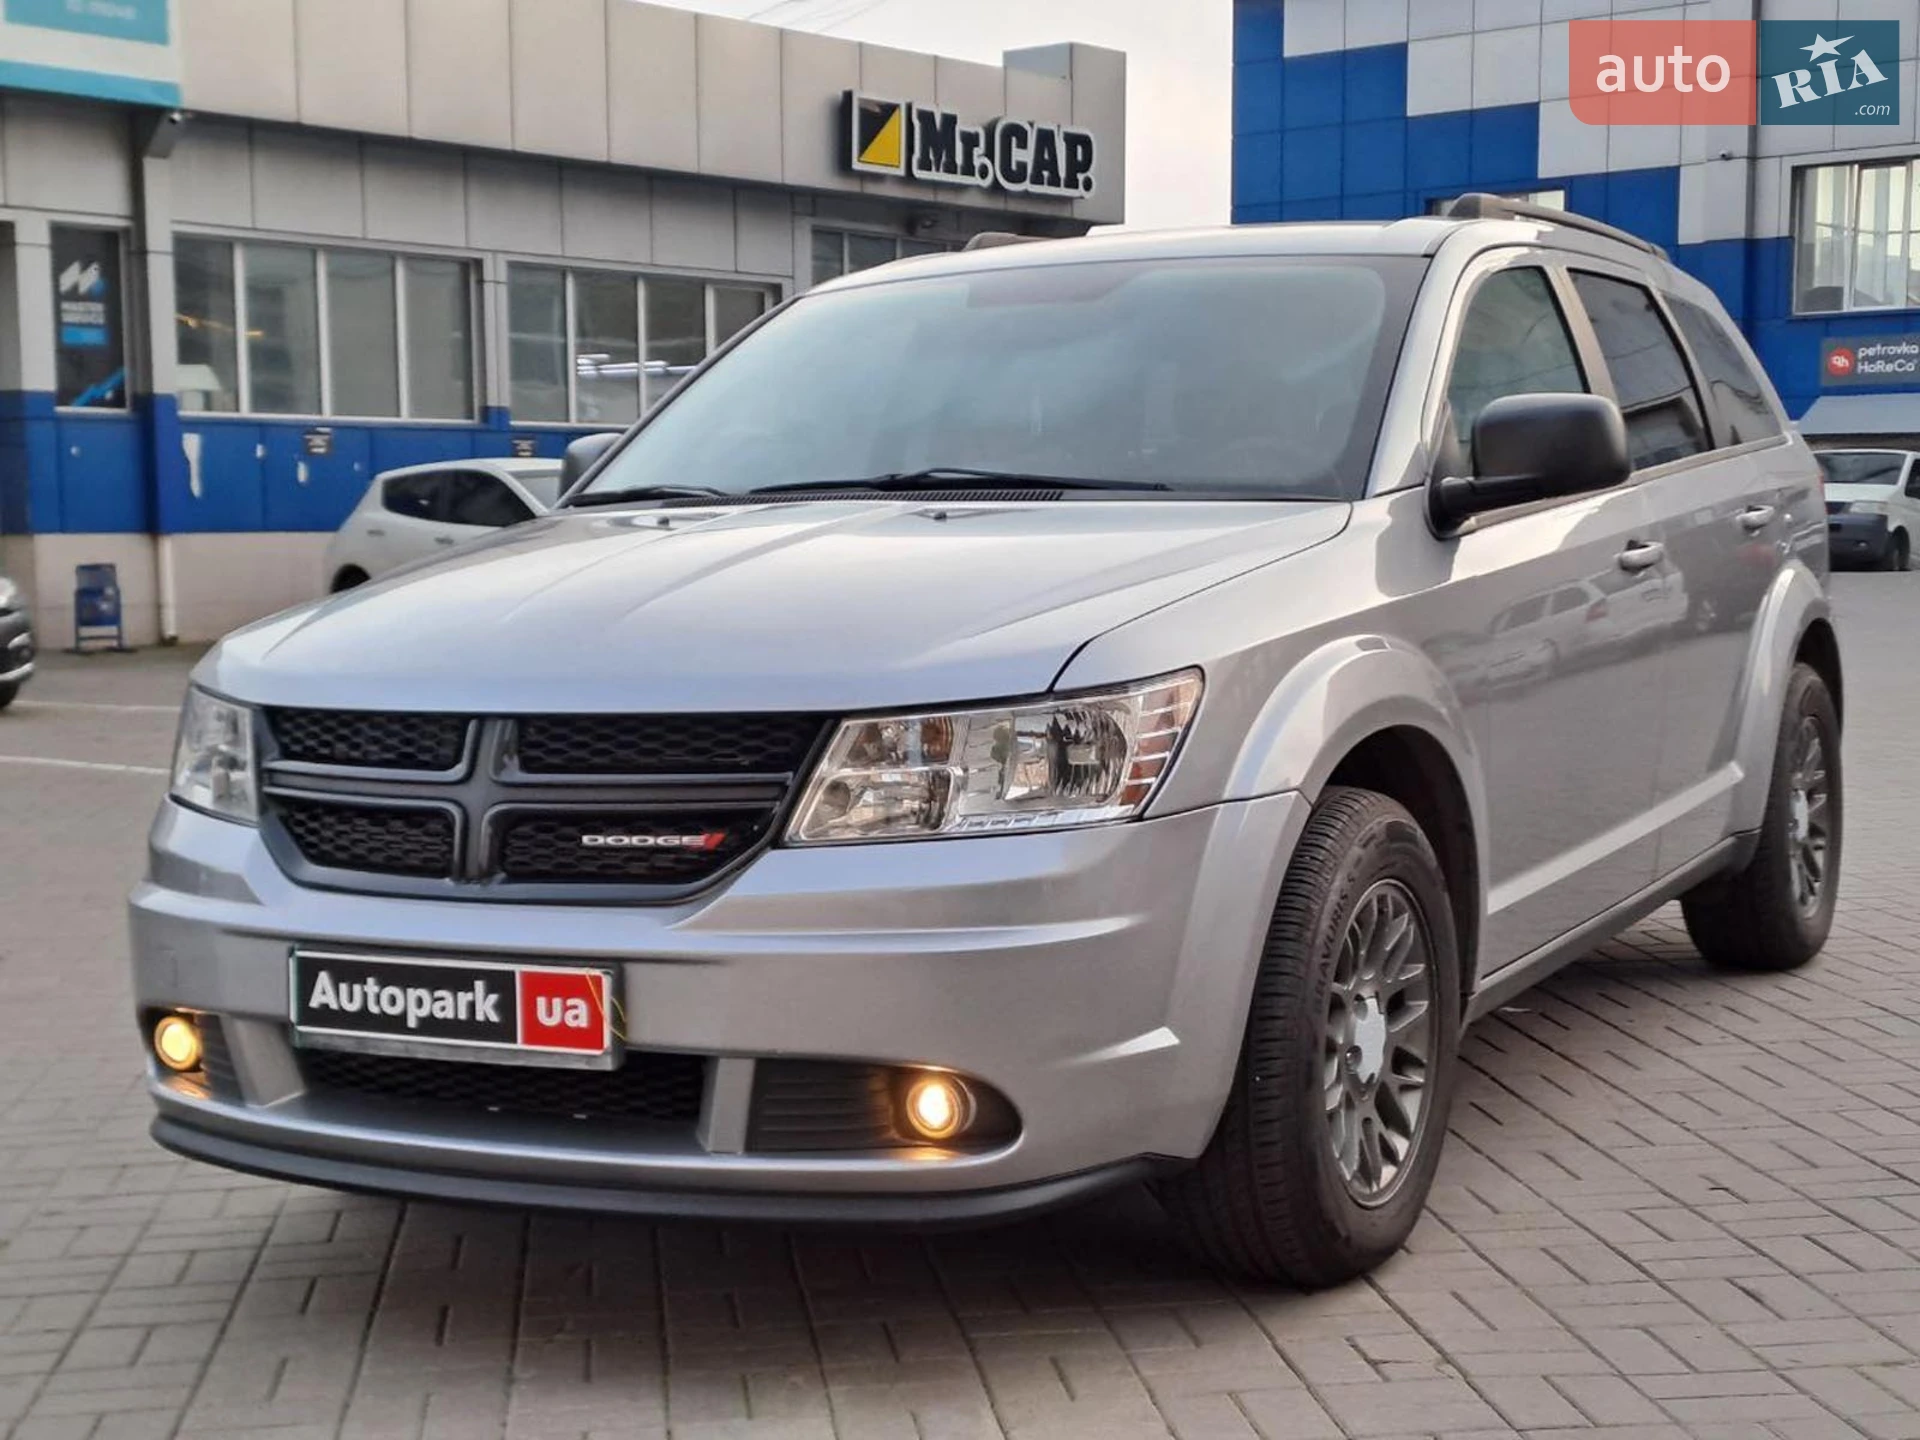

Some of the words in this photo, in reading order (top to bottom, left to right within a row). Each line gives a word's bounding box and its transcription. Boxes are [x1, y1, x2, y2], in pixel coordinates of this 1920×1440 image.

[999, 121, 1093, 192] CAP.
[1858, 341, 1919, 360] petrovka
[1857, 358, 1915, 375] HoReCa
[581, 834, 706, 847] DODGE
[308, 970, 501, 1029] Autopark
[535, 995, 590, 1029] ua
